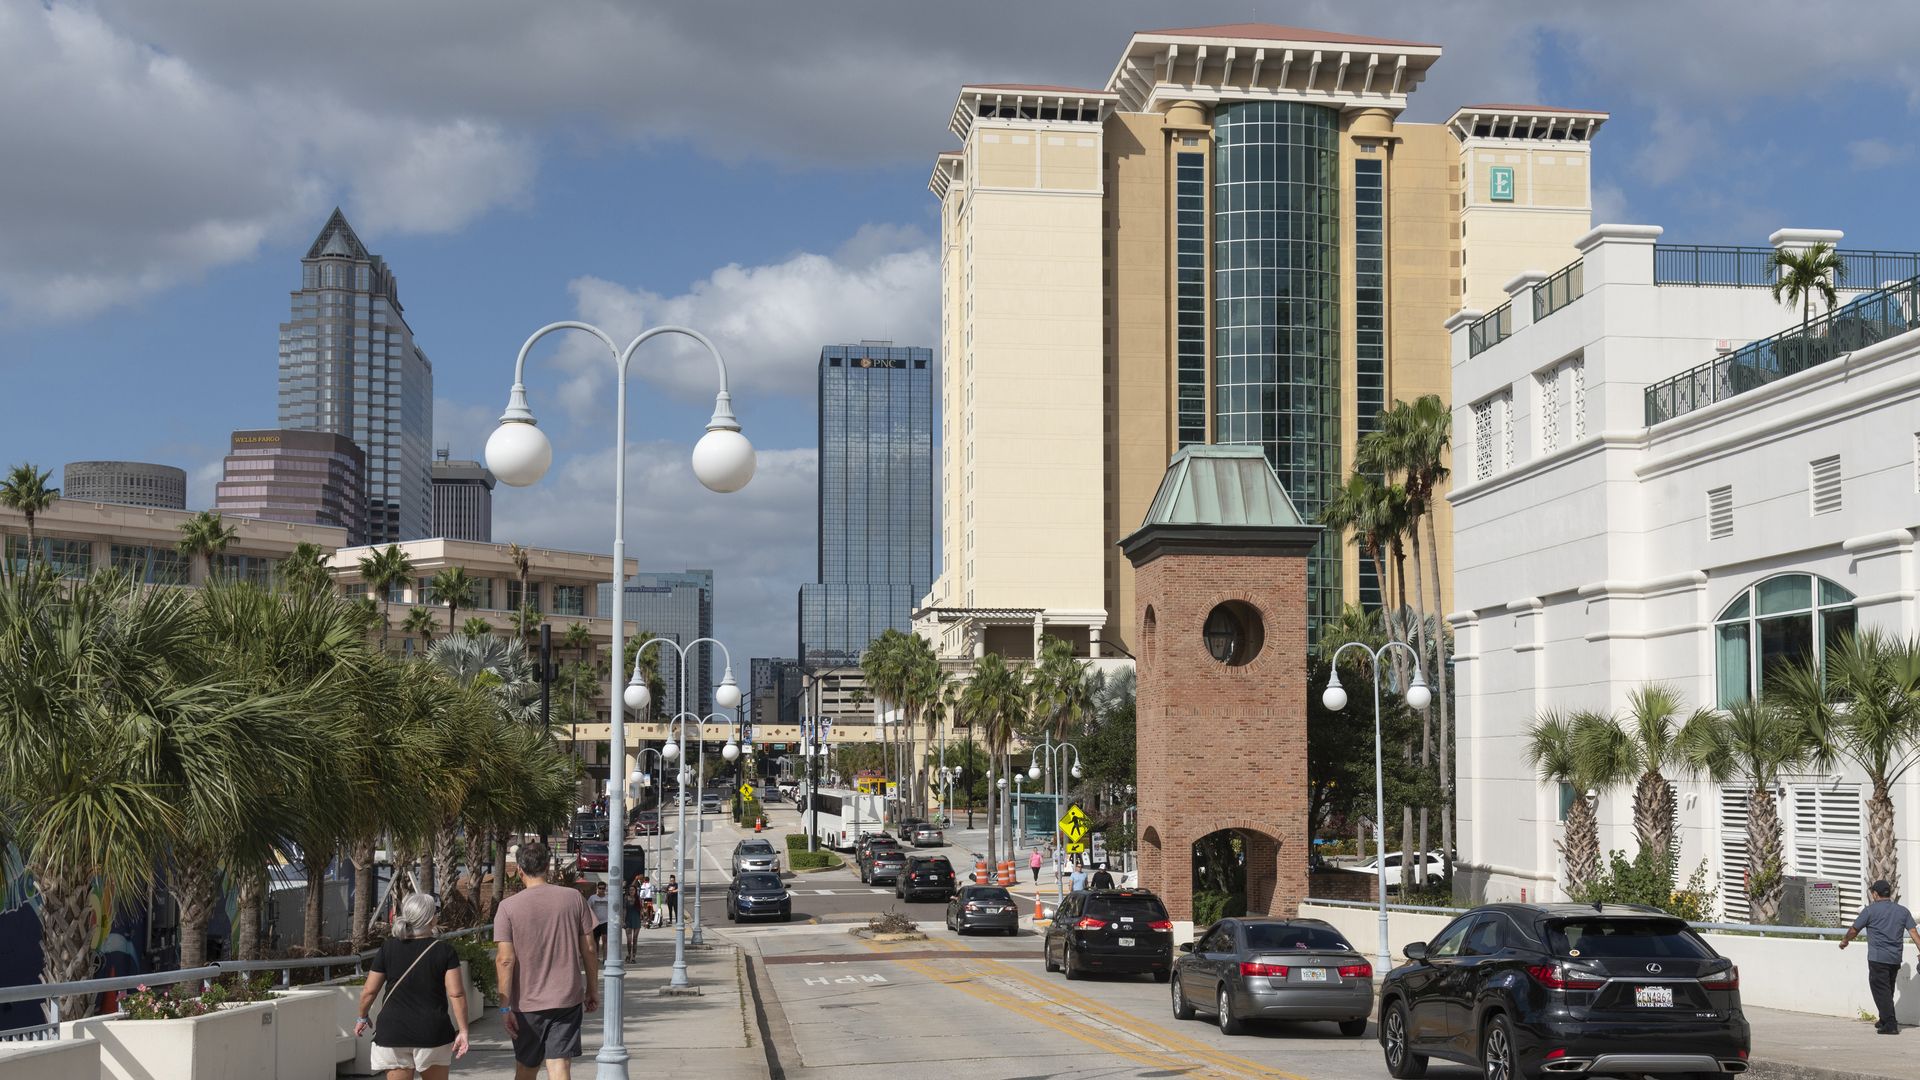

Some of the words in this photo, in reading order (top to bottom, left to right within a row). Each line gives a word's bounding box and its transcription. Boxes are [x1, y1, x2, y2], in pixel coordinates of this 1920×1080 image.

[1495, 172, 1509, 194] E
[873, 360, 896, 368] PNC
[803, 973, 888, 986] MPH
